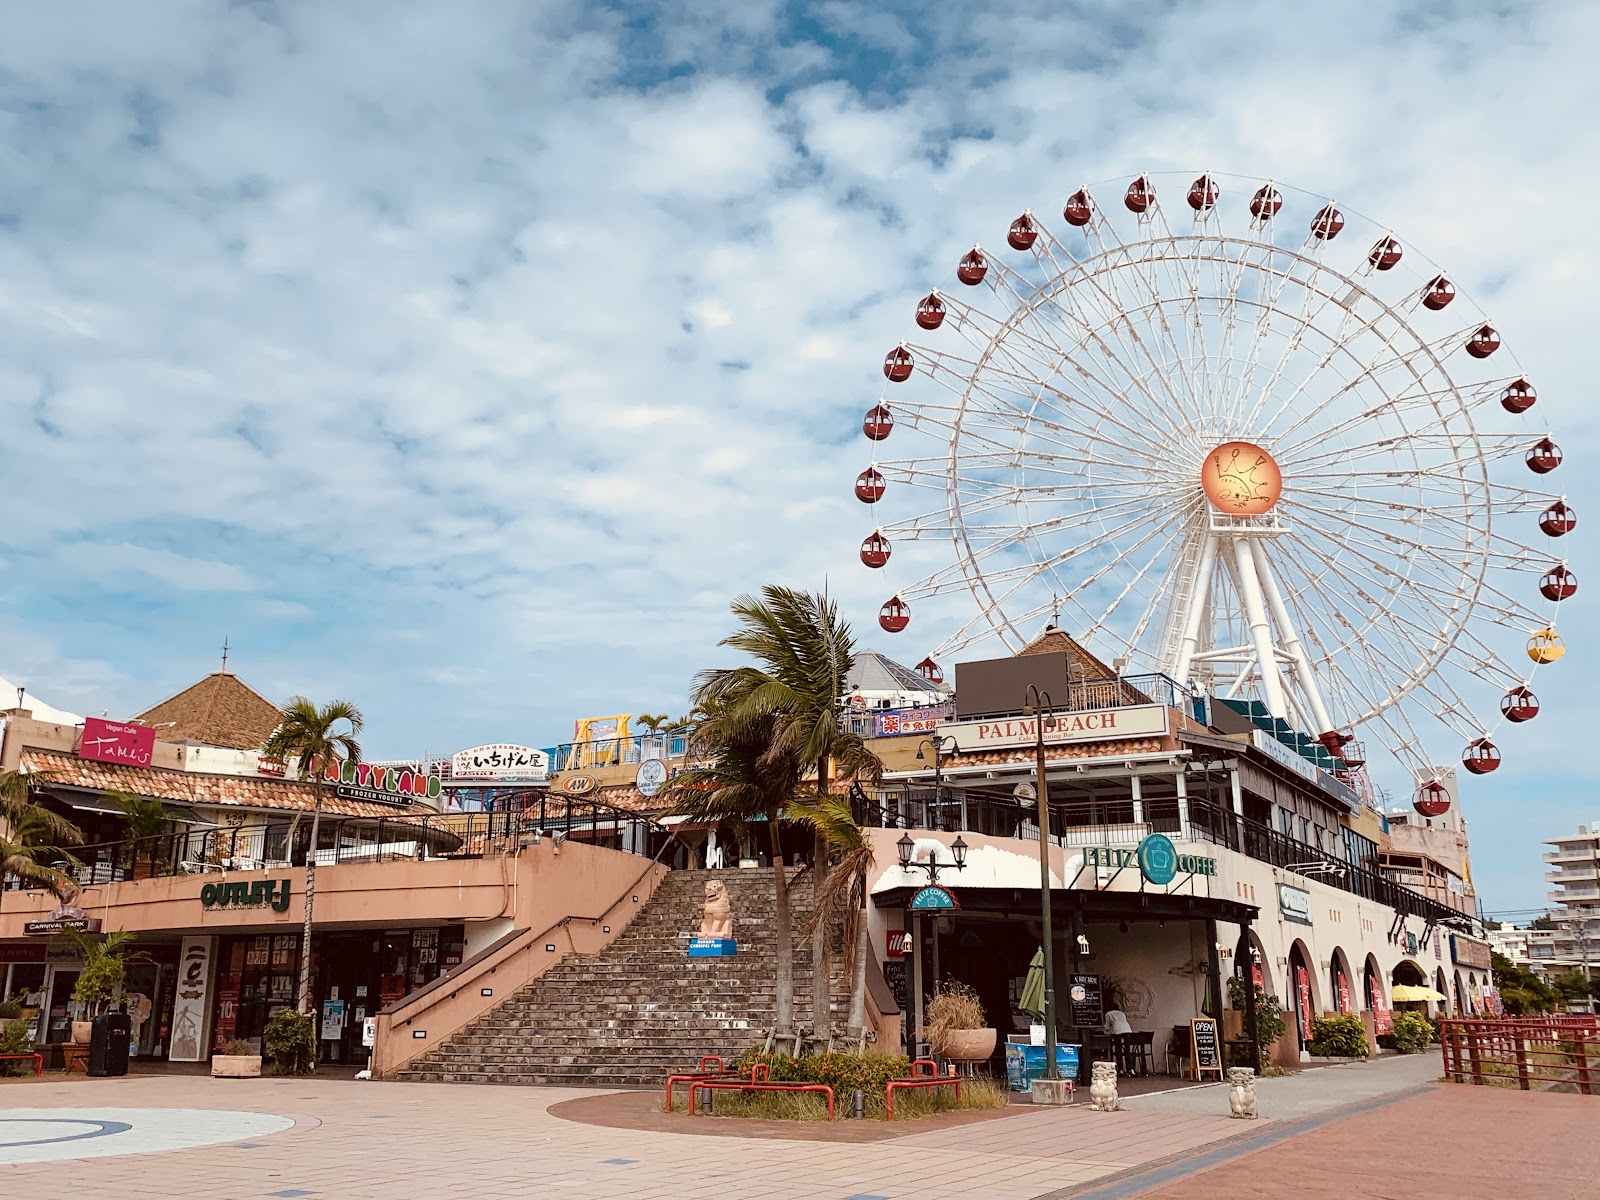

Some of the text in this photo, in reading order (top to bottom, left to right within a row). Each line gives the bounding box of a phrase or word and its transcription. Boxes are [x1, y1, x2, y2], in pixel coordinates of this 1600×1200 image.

[105, 723, 123, 732] Vegan
[912, 720, 937, 732] 免税
[978, 713, 1117, 739] PALM BEACH
[474, 750, 545, 768] いちげん屋
[350, 789, 403, 803] FROZEN YOGURT
[1083, 847, 1218, 876] FELIZ COFFEE
[201, 879, 291, 911] OUTLET-J
[915, 889, 950, 905] FELIZ COFFEE
[29, 922, 62, 930] CARNIVAL
[1196, 1022, 1214, 1031] OPEN
